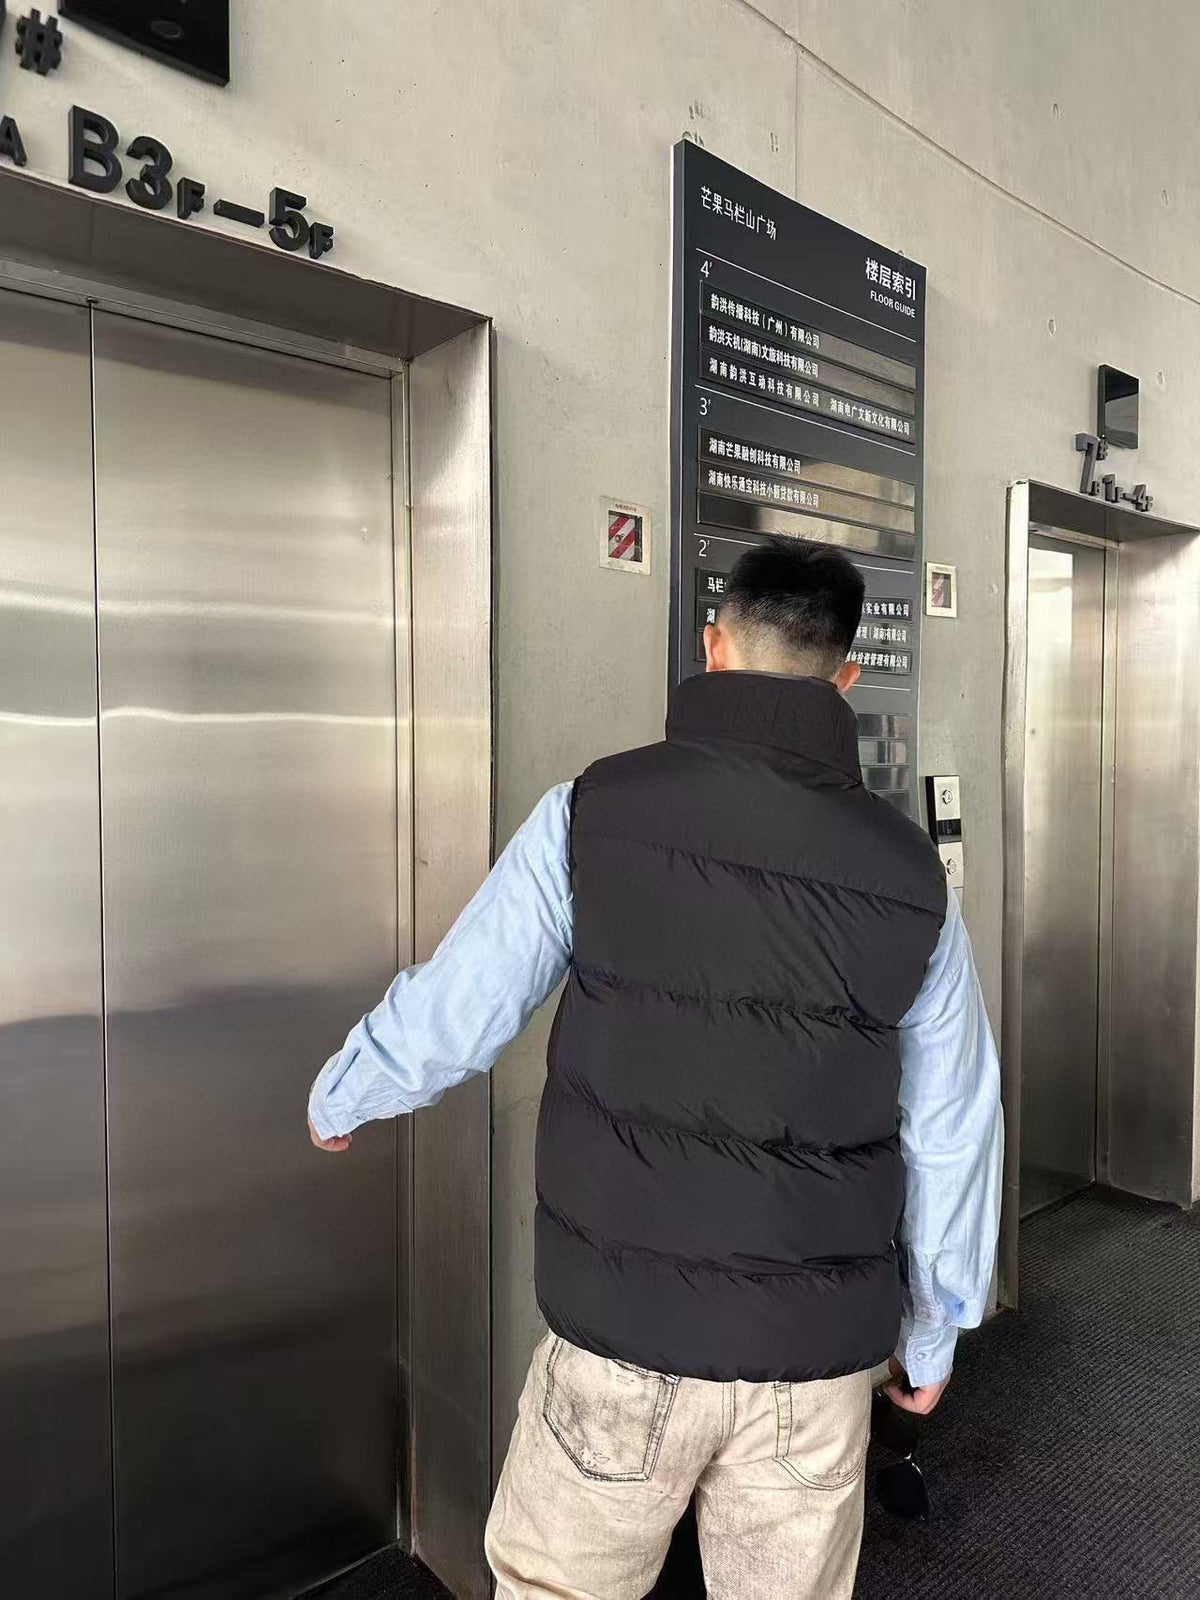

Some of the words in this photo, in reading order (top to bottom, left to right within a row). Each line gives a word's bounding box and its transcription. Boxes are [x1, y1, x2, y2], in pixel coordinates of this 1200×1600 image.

[701, 185, 777, 240] 芒果马栏山广场
[865, 257, 916, 300] 楼层索引
[870, 290, 894, 309] FLOOR
[894, 298, 916, 318] GUIDE
[709, 357, 819, 407] 湖南韵洪互动科技有限公司
[709, 437, 801, 474] 湖南芒果融创科技有限公司
[708, 469, 819, 507] 湖南快乐通宝科技小额贷款有限公司
[707, 576, 727, 593] 马栏
